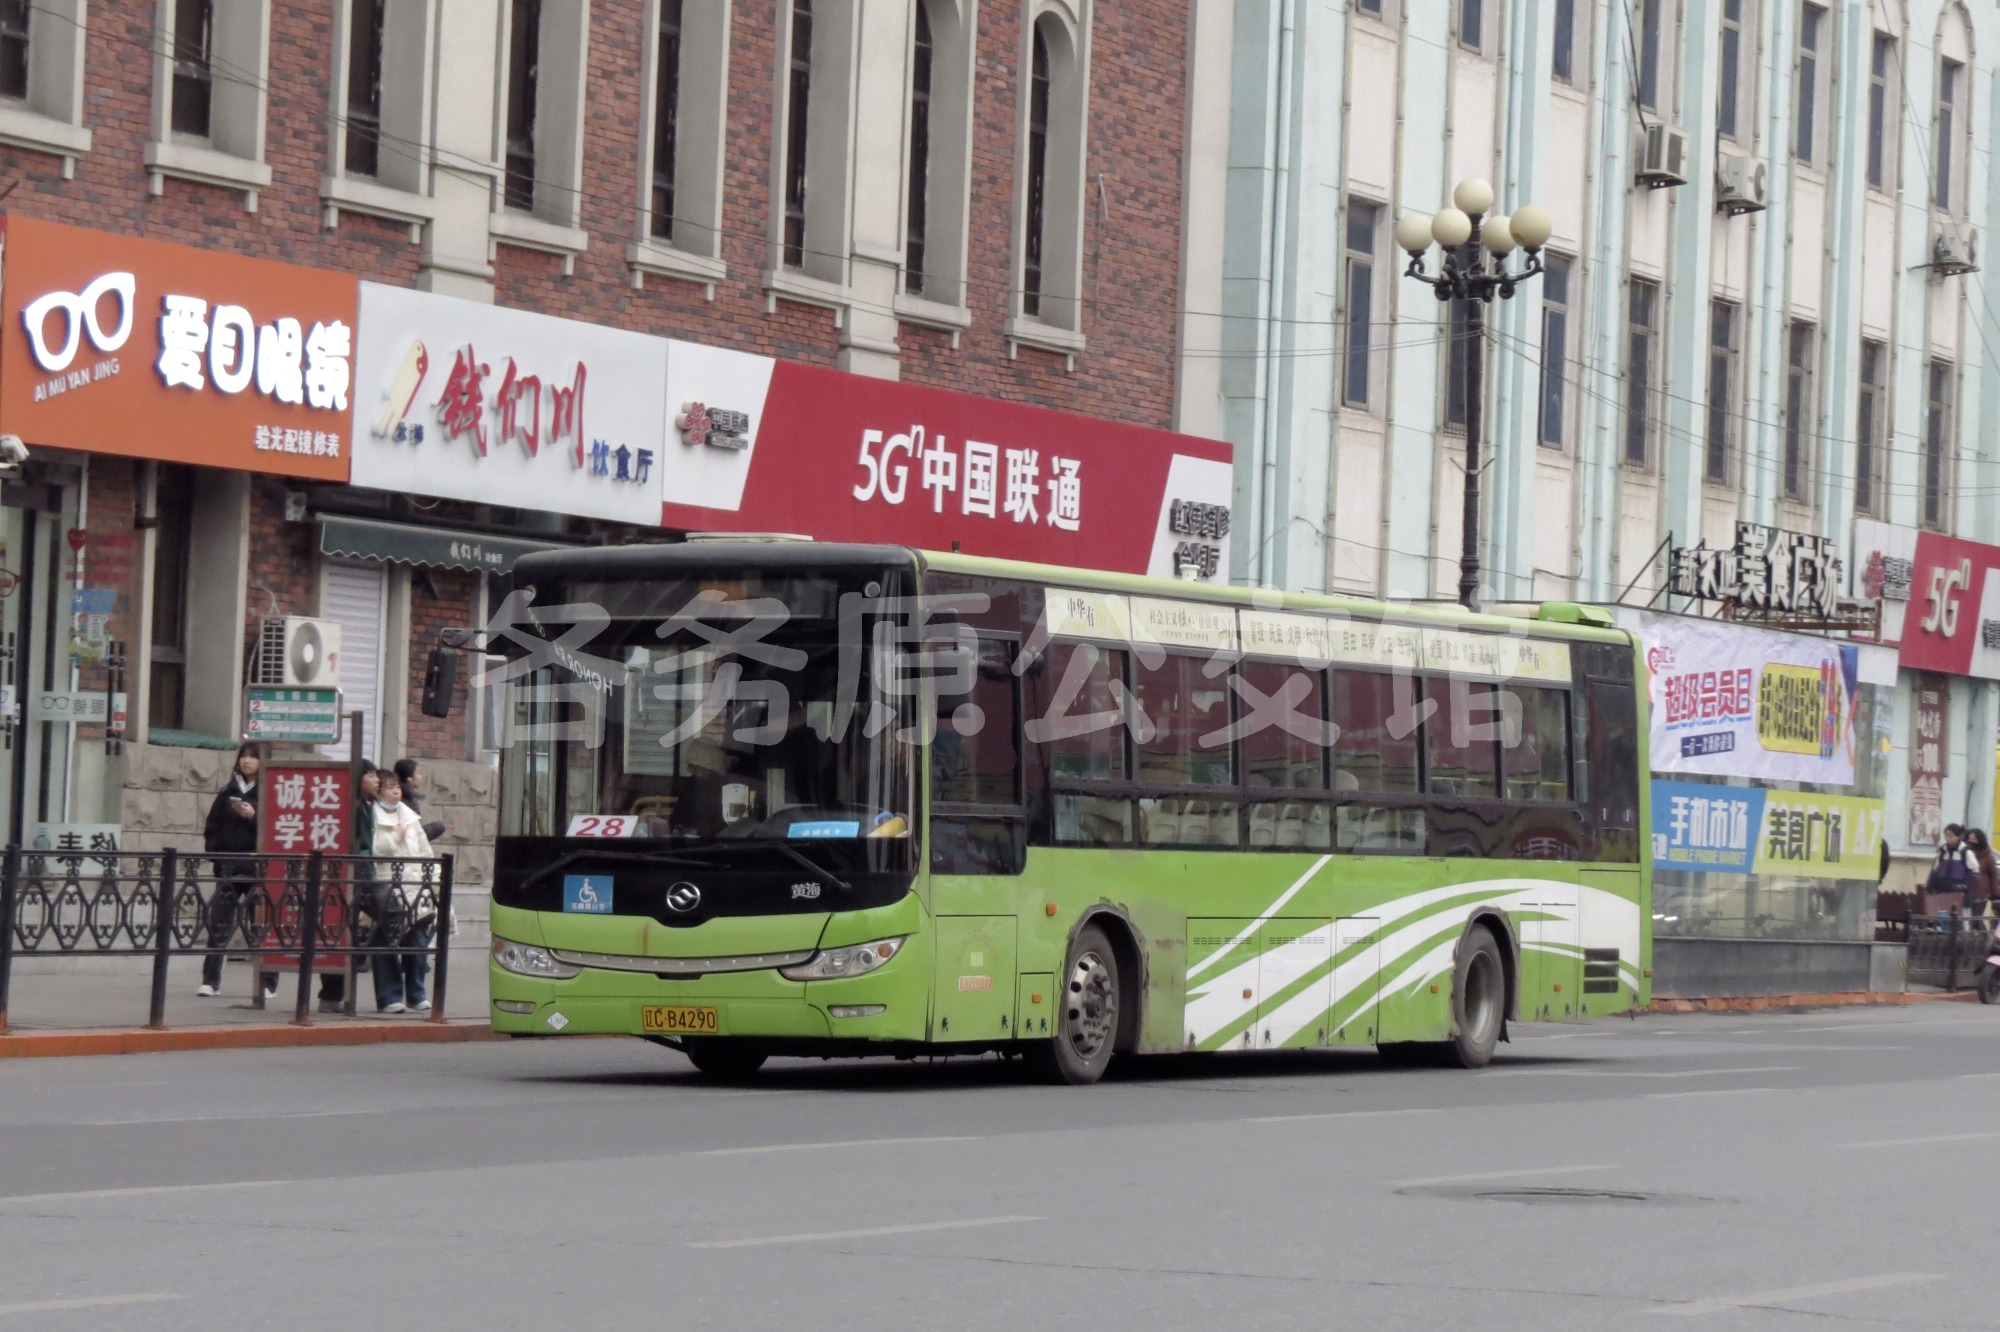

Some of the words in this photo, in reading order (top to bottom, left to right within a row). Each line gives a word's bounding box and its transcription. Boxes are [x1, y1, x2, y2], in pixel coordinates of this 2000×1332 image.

[156, 294, 350, 411] 爱目眼镜
[35, 382, 47, 402] AI
[49, 376, 67, 397] MU
[67, 367, 91, 390] YAN
[93, 357, 120, 381] JING
[255, 425, 340, 458] 验光配镜修表
[922, 434, 1082, 531] 中国联通
[1664, 668, 1752, 723] 超级会员日
[273, 774, 342, 810] 诚达
[274, 814, 341, 851] 学校
[574, 817, 626, 838] 28
[1669, 796, 1748, 850] 手机市场
[1768, 808, 1842, 863] 美食广场
[791, 882, 822, 899] 黄海
[550, 1016, 567, 1026] LNG
